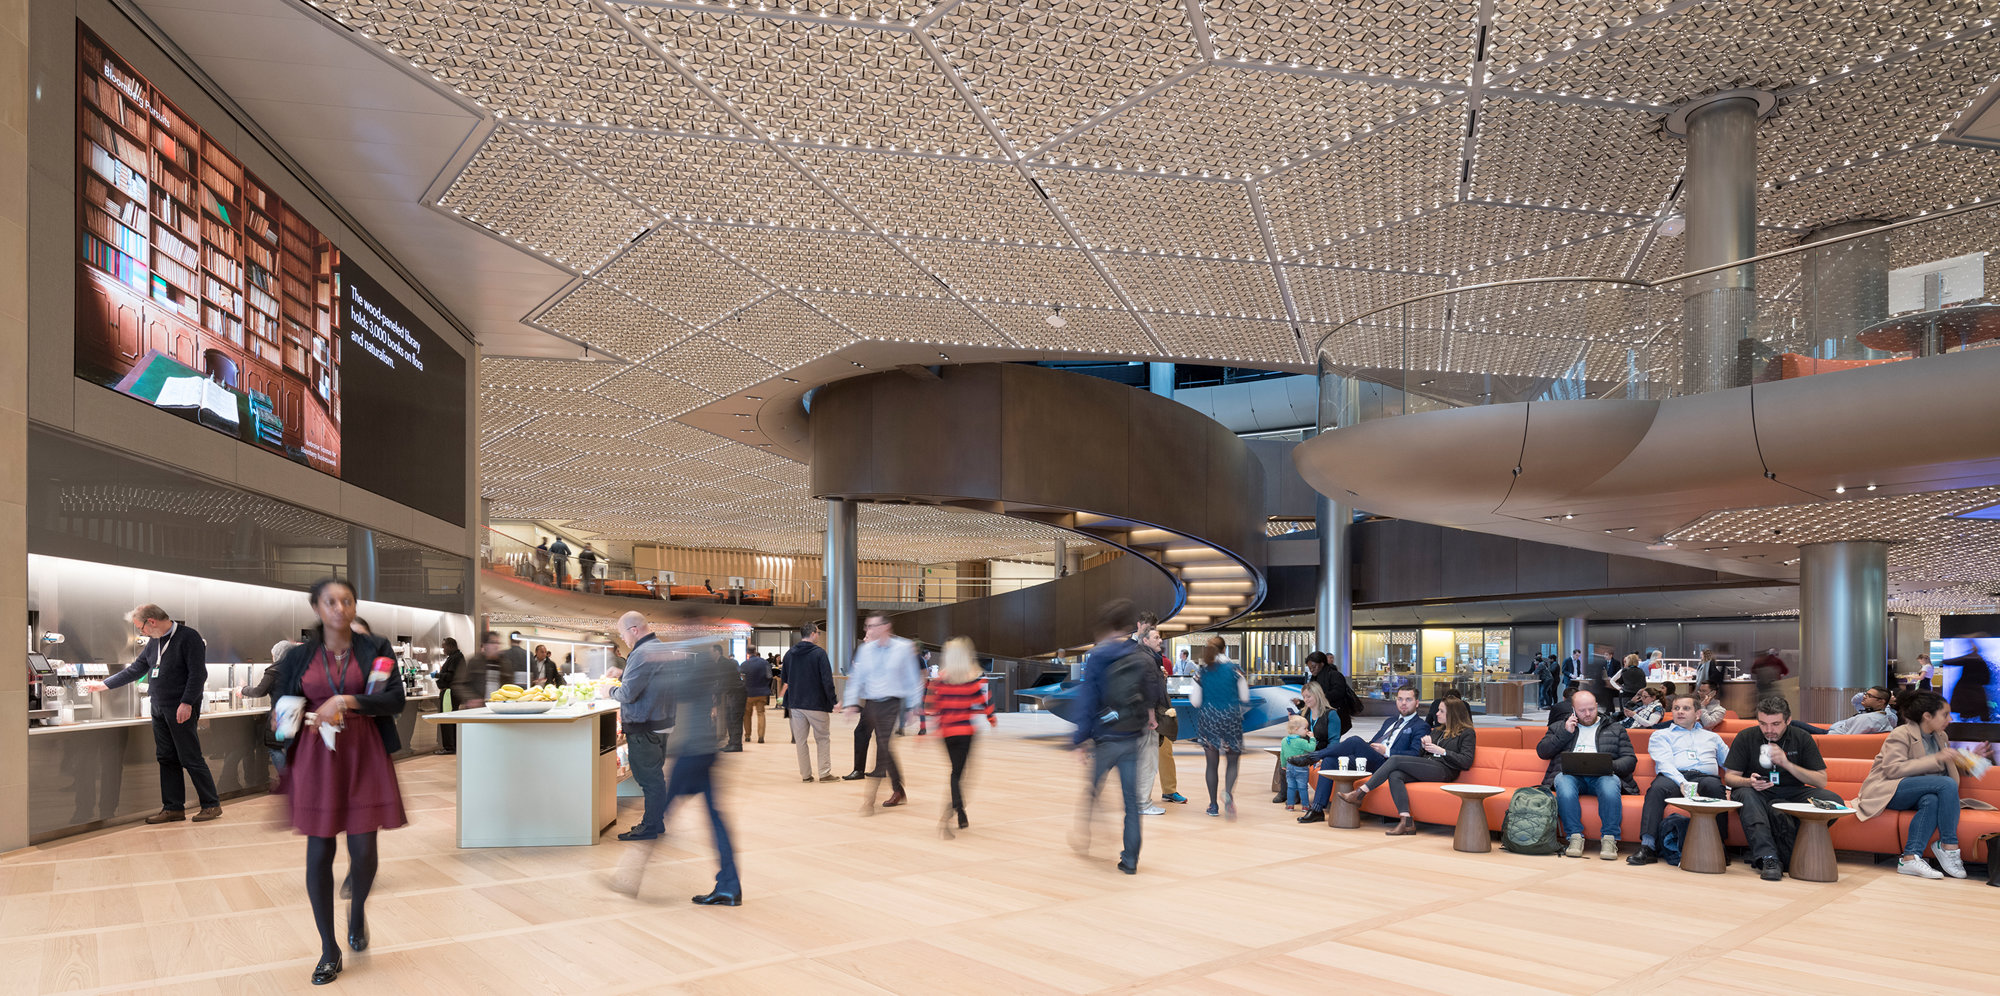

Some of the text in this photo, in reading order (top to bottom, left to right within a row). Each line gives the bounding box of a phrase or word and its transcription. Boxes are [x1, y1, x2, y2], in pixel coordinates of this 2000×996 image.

[104, 64, 170, 128] Bloomberg Pursuits
[350, 284, 421, 354] The wood-paneled library
[350, 305, 424, 371] holds 3,000 books on flora
[350, 330, 395, 369] and naturalism.
